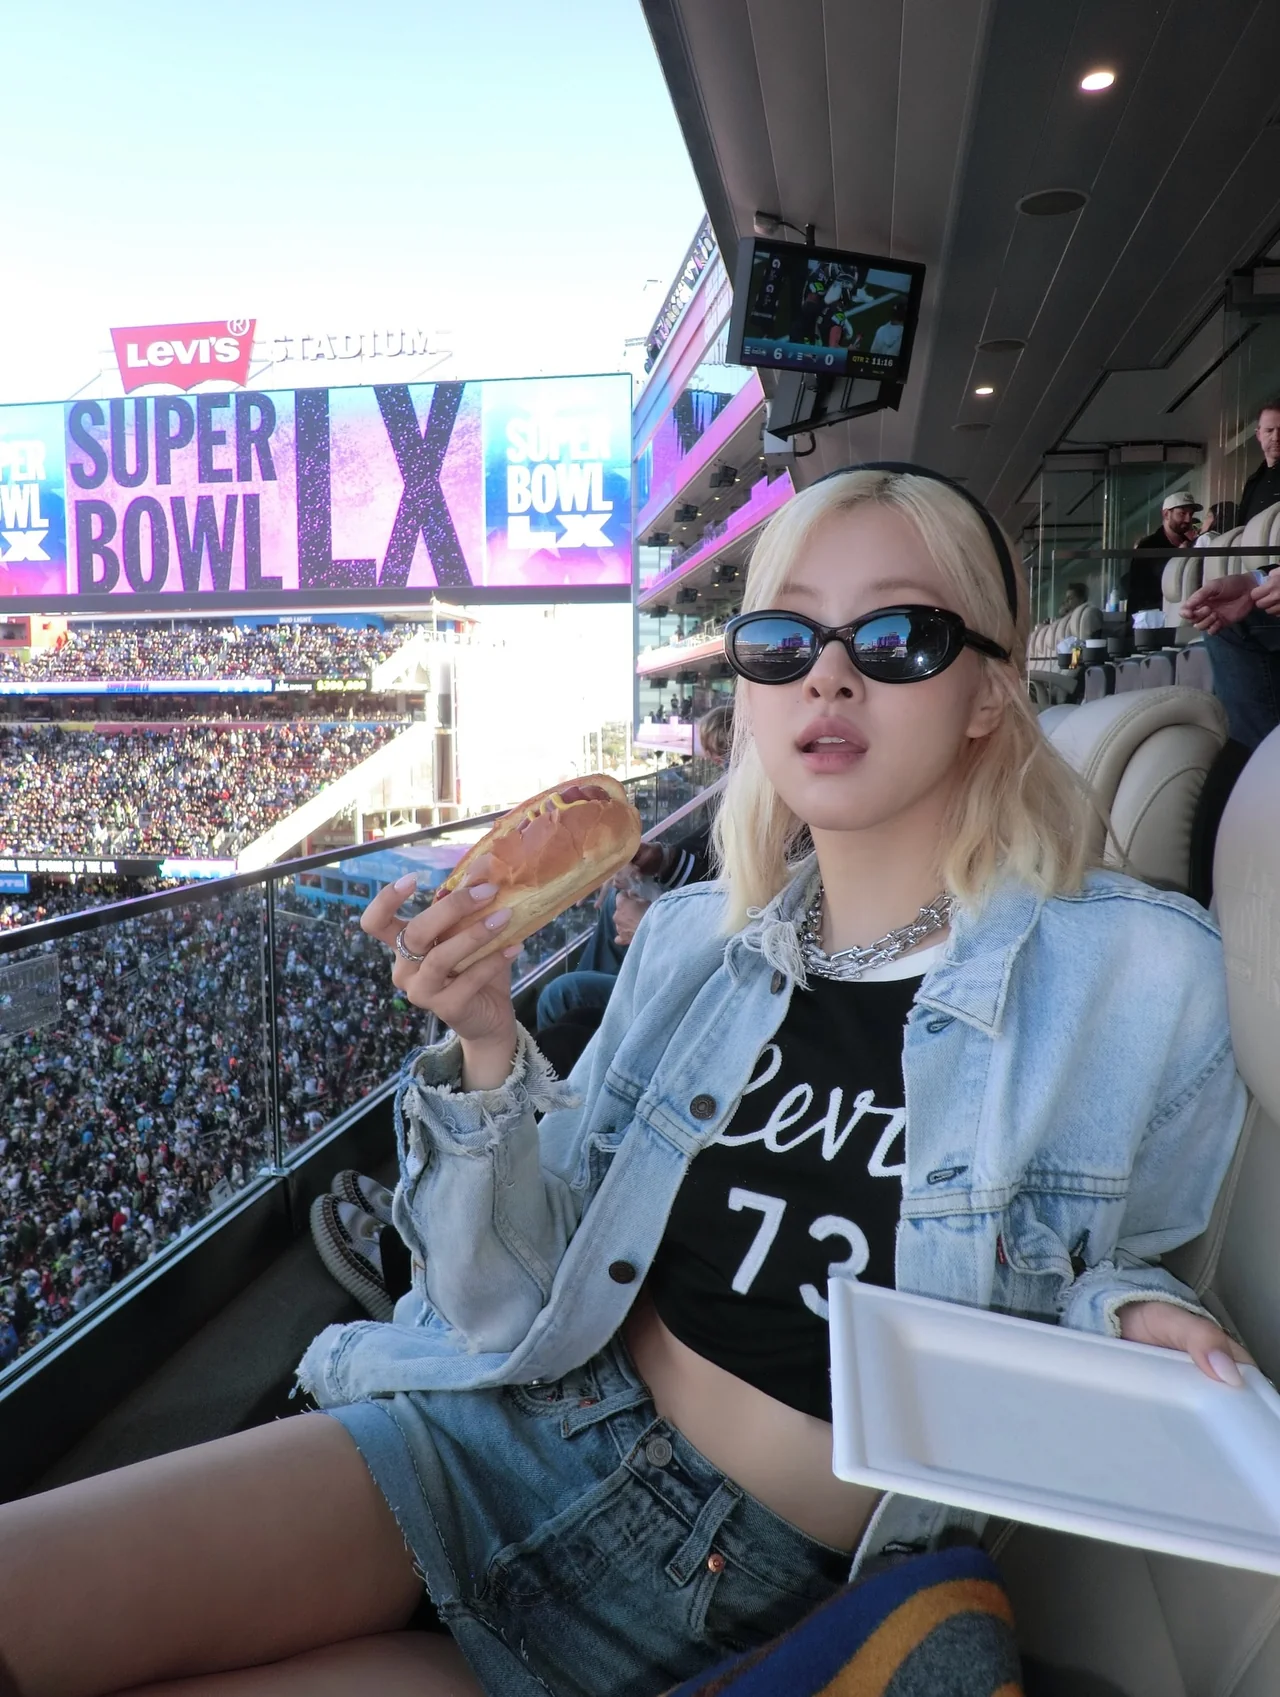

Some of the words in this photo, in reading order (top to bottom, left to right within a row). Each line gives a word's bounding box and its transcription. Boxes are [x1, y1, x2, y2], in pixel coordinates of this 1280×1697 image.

[265, 328, 437, 363] STADIUM
[773, 348, 783, 360] 6
[824, 354, 834, 366] 0
[68, 391, 277, 489] SUPER
[507, 418, 612, 462] SUPER
[0, 483, 49, 529] WL
[295, 382, 473, 589] LX
[507, 463, 613, 513] BOWL
[0, 530, 51, 562] X
[75, 494, 283, 594] BOWL
[508, 514, 614, 549] LX
[279, 616, 293, 624] BUD
[293, 616, 313, 624] LIGHT
[728, 1186, 870, 1321] 73
